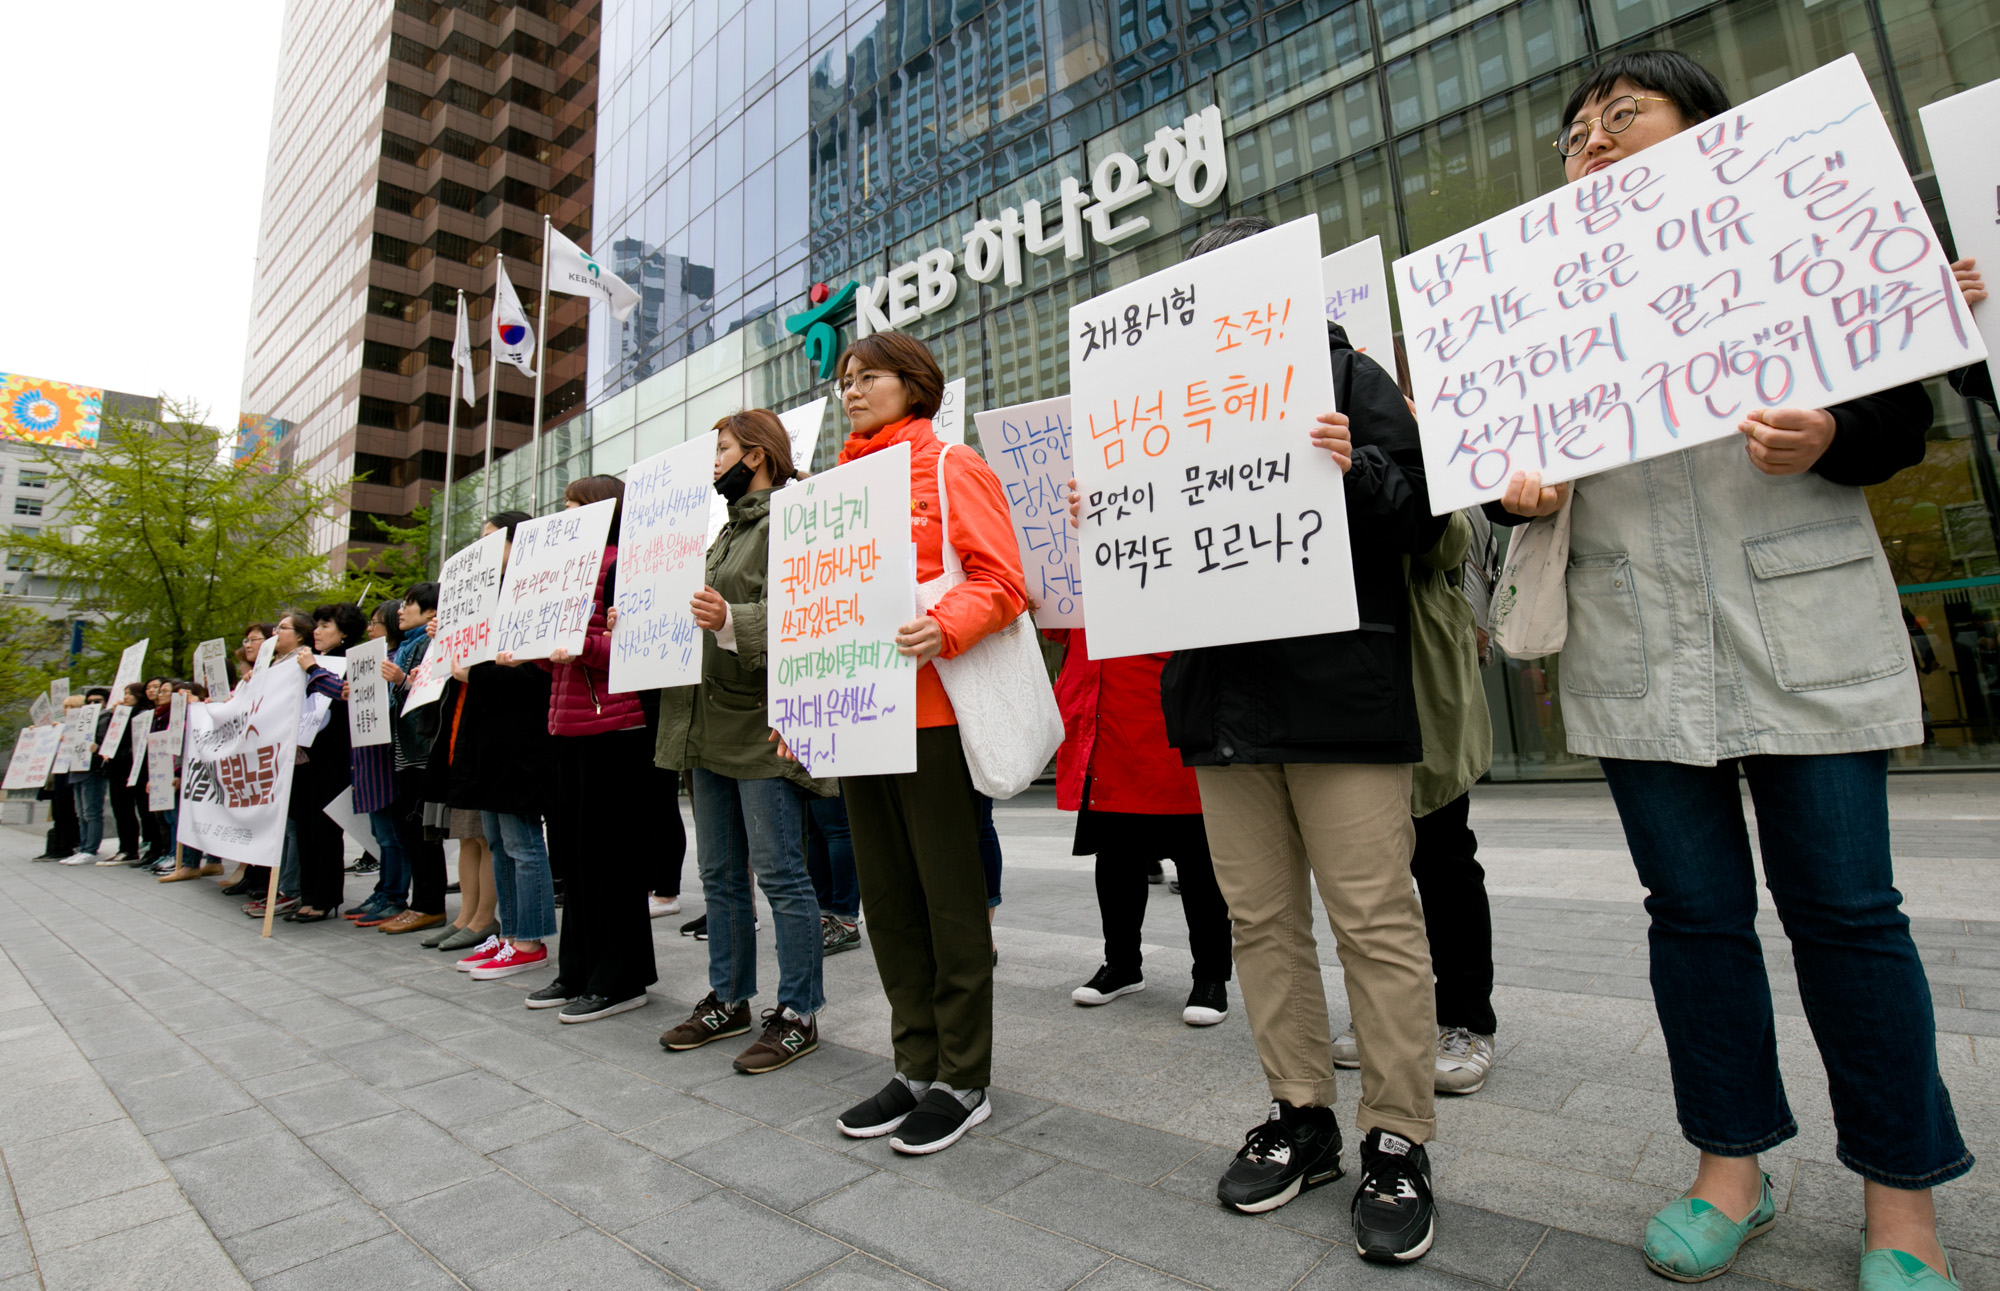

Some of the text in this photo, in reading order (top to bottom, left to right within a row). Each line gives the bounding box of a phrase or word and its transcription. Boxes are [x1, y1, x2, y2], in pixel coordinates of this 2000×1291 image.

[856, 104, 1228, 340] KEB 하나은행
[1410, 232, 1497, 307] 남자
[1520, 203, 1559, 243] 더
[1575, 166, 1666, 234] 뽑은
[569, 272, 587, 284] KEB
[1416, 286, 1547, 362] 같지도
[1553, 243, 1638, 310] 않은
[1657, 196, 1754, 257] 이유
[1431, 312, 1628, 418] 생각하지
[1647, 268, 1766, 337] 말고
[1769, 201, 1930, 296] 당장
[1831, 264, 1968, 371] 멈춰
[1079, 284, 1292, 361] 채용시험 조작!
[1088, 364, 1294, 470] 남성 특혜!
[628, 460, 672, 501] 여자는
[1087, 453, 1291, 526] 무엇이 문제인지
[1095, 509, 1323, 589] 아직도 모르나?
[618, 582, 656, 625] 차라리
[782, 1029, 805, 1053] N
